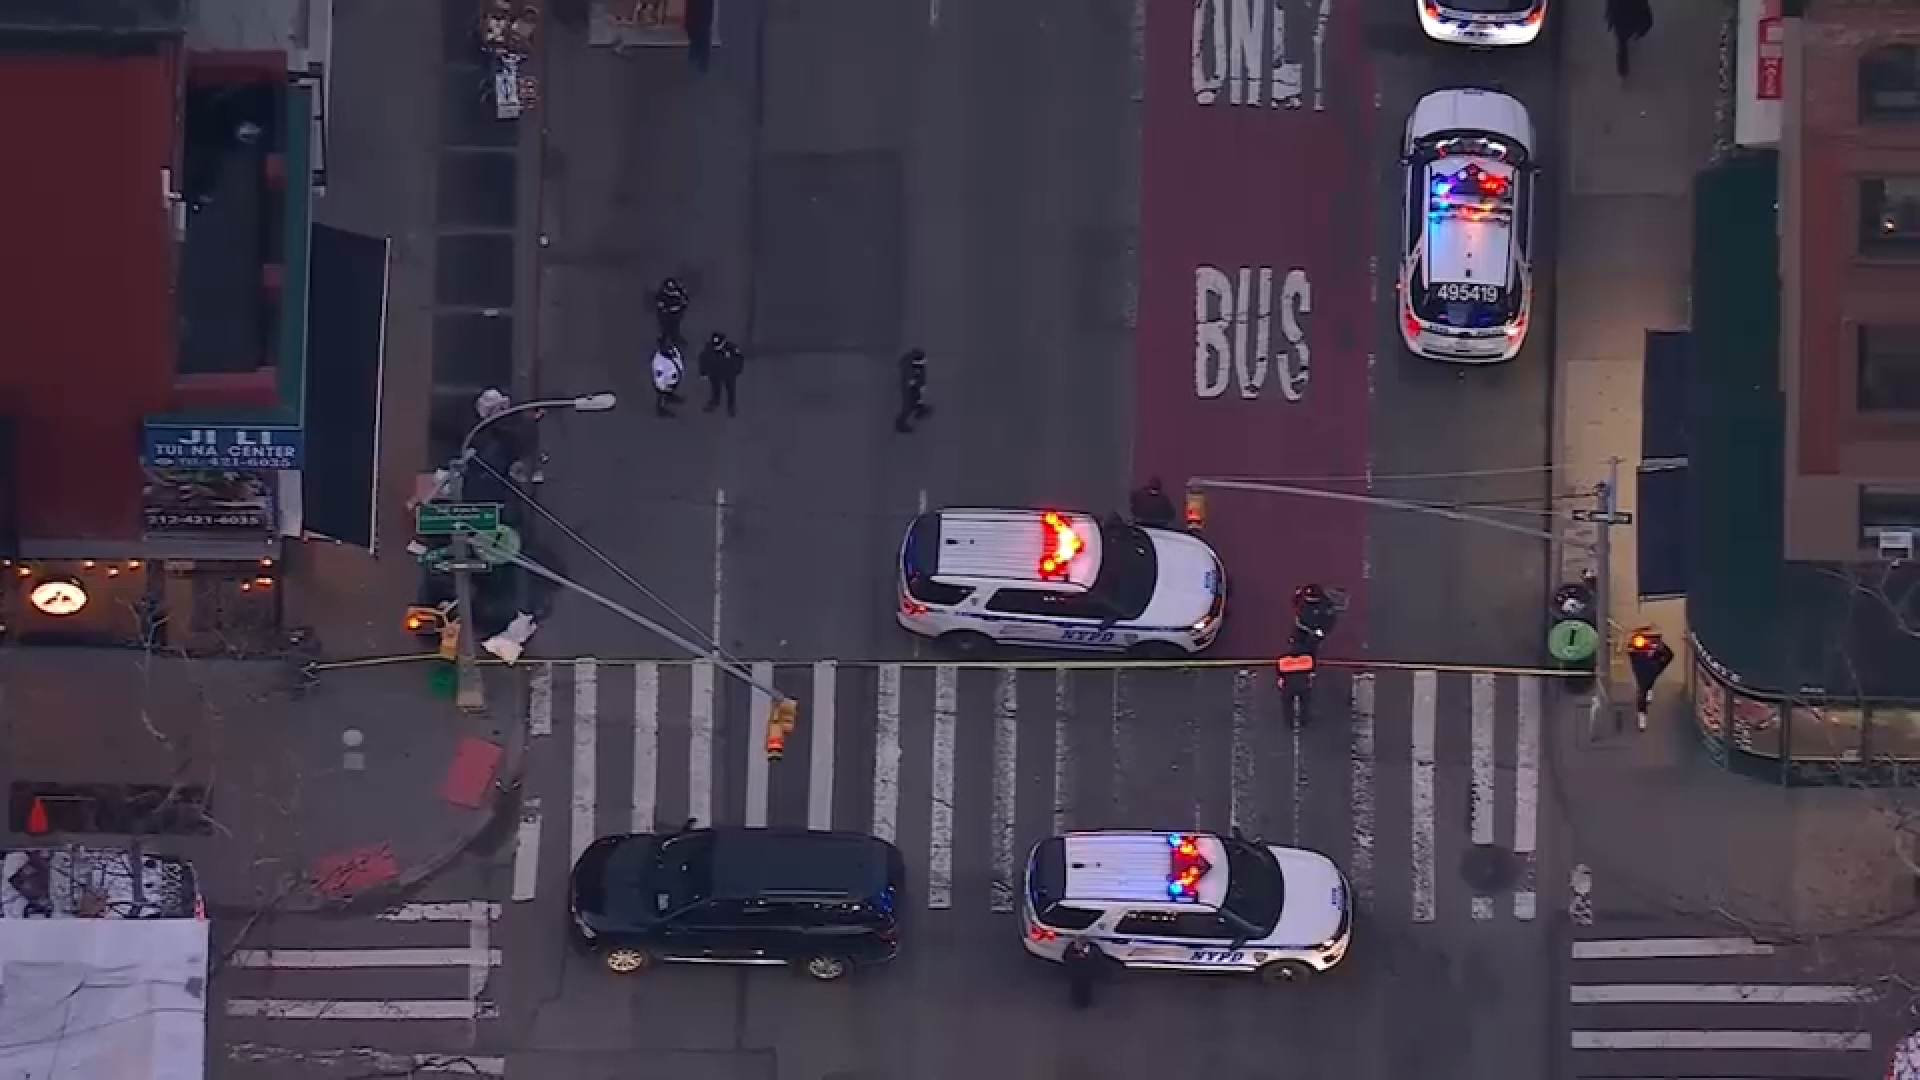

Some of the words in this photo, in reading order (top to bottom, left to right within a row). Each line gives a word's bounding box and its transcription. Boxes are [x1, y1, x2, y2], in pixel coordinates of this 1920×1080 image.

[1193, 0, 1330, 111] ONLY
[1437, 284, 1498, 302] 495419
[1196, 266, 1311, 400] BUS
[178, 429, 217, 444] JI
[235, 431, 272, 444] LI
[155, 444, 183, 455] TUI
[191, 445, 219, 456] NA
[227, 445, 295, 457] CENTER
[1060, 630, 1115, 642] NYPD
[1190, 951, 1245, 963] NYPD
